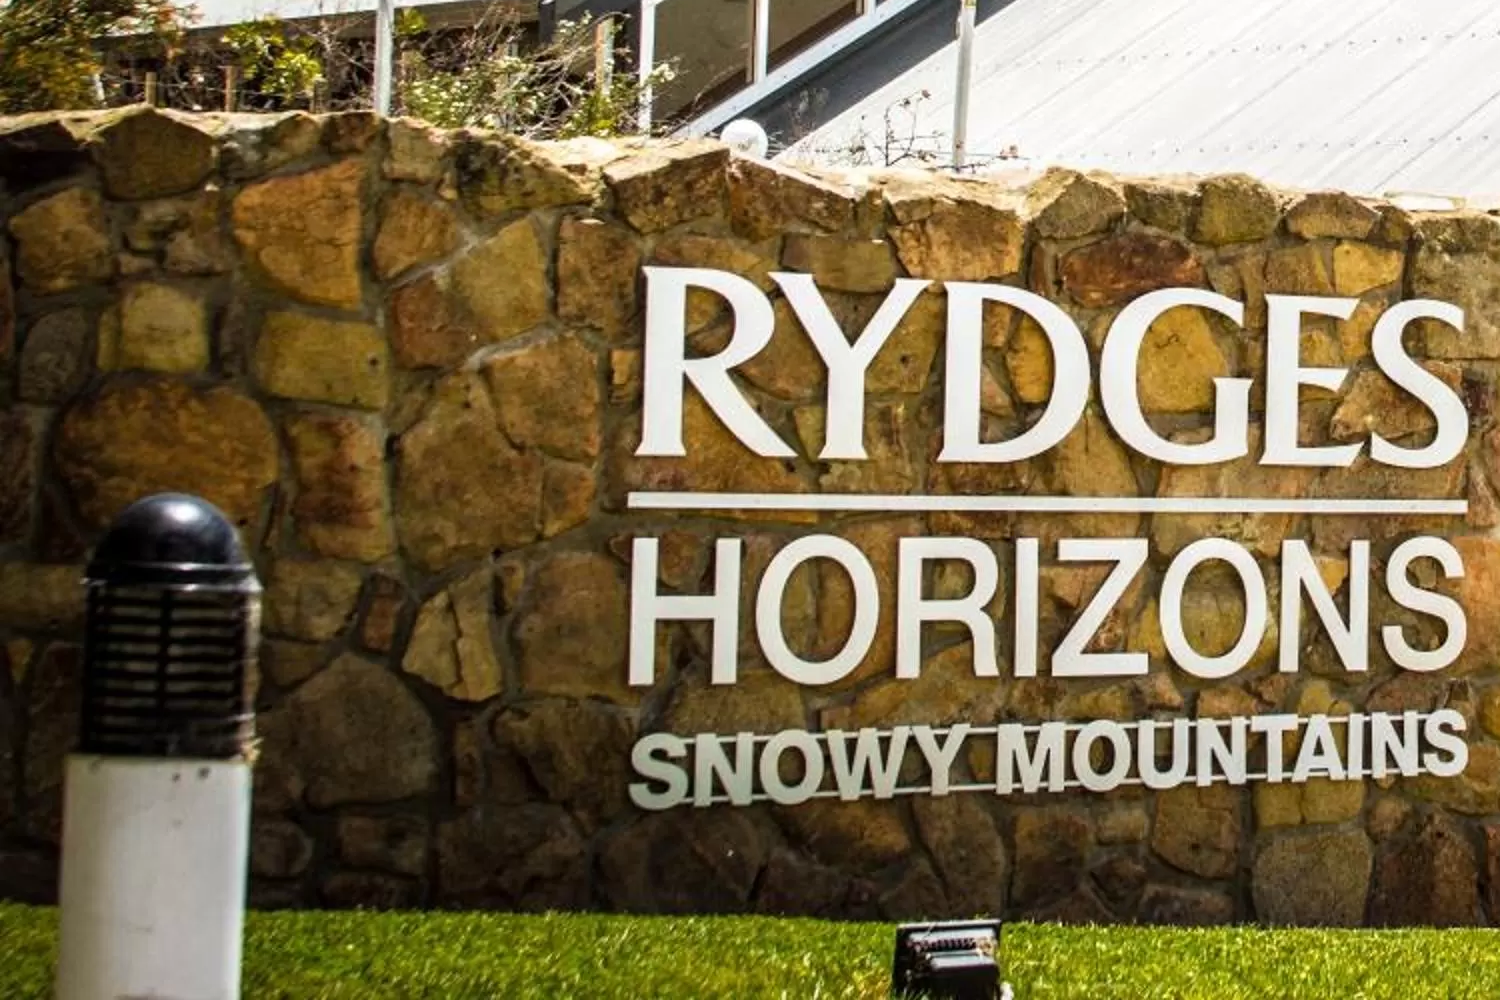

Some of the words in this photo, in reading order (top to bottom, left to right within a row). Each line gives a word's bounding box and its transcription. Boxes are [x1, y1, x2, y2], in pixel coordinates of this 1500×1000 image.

[635, 265, 1469, 469] RYDGES
[628, 533, 1467, 686] HORIZONS
[629, 723, 971, 810] SNOWY
[995, 708, 1469, 795] MOUNTAINS
